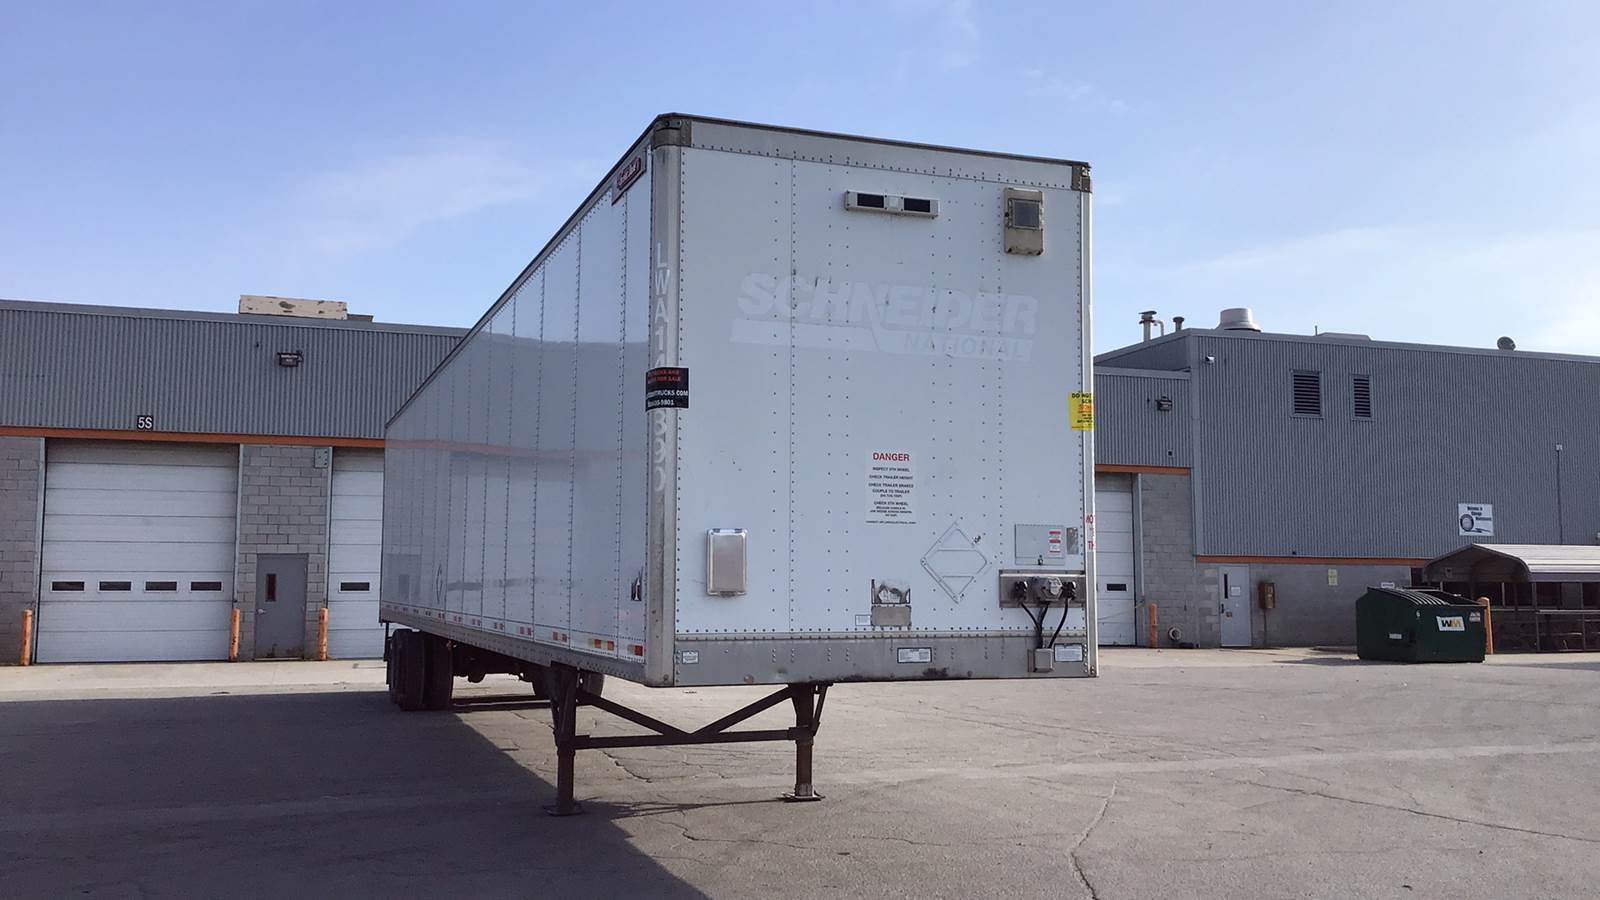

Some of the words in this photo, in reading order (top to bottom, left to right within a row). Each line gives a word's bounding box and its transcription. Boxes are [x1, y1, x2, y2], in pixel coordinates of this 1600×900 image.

[736, 272, 1039, 336] SCHNEIDER
[138, 416, 153, 429] 5S
[872, 452, 910, 461] DANGER
[1441, 619, 1461, 628] WM
